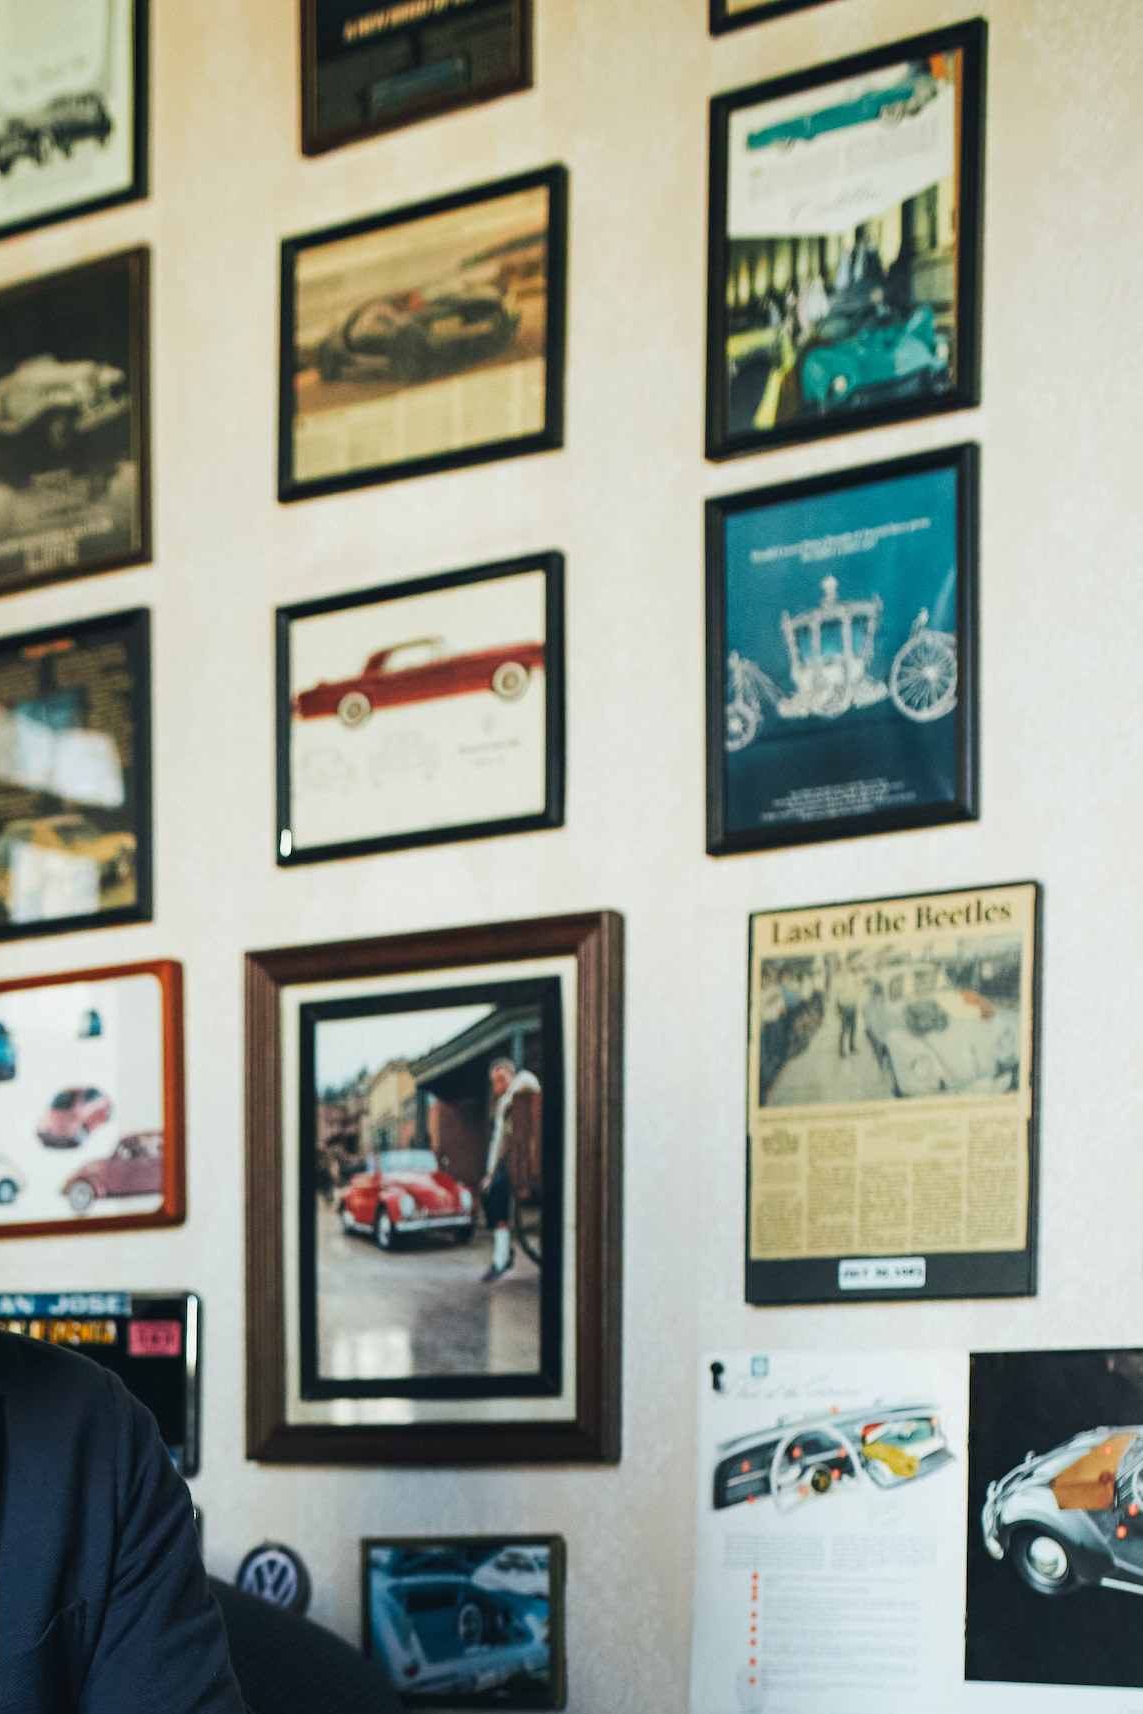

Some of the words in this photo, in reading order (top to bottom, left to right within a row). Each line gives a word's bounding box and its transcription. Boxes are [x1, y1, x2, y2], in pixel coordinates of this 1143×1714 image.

[771, 919, 822, 944] Last
[832, 912, 861, 937] of
[865, 911, 906, 934] the
[915, 899, 1012, 930] Beetles
[48, 1295, 119, 1315] JOSE
